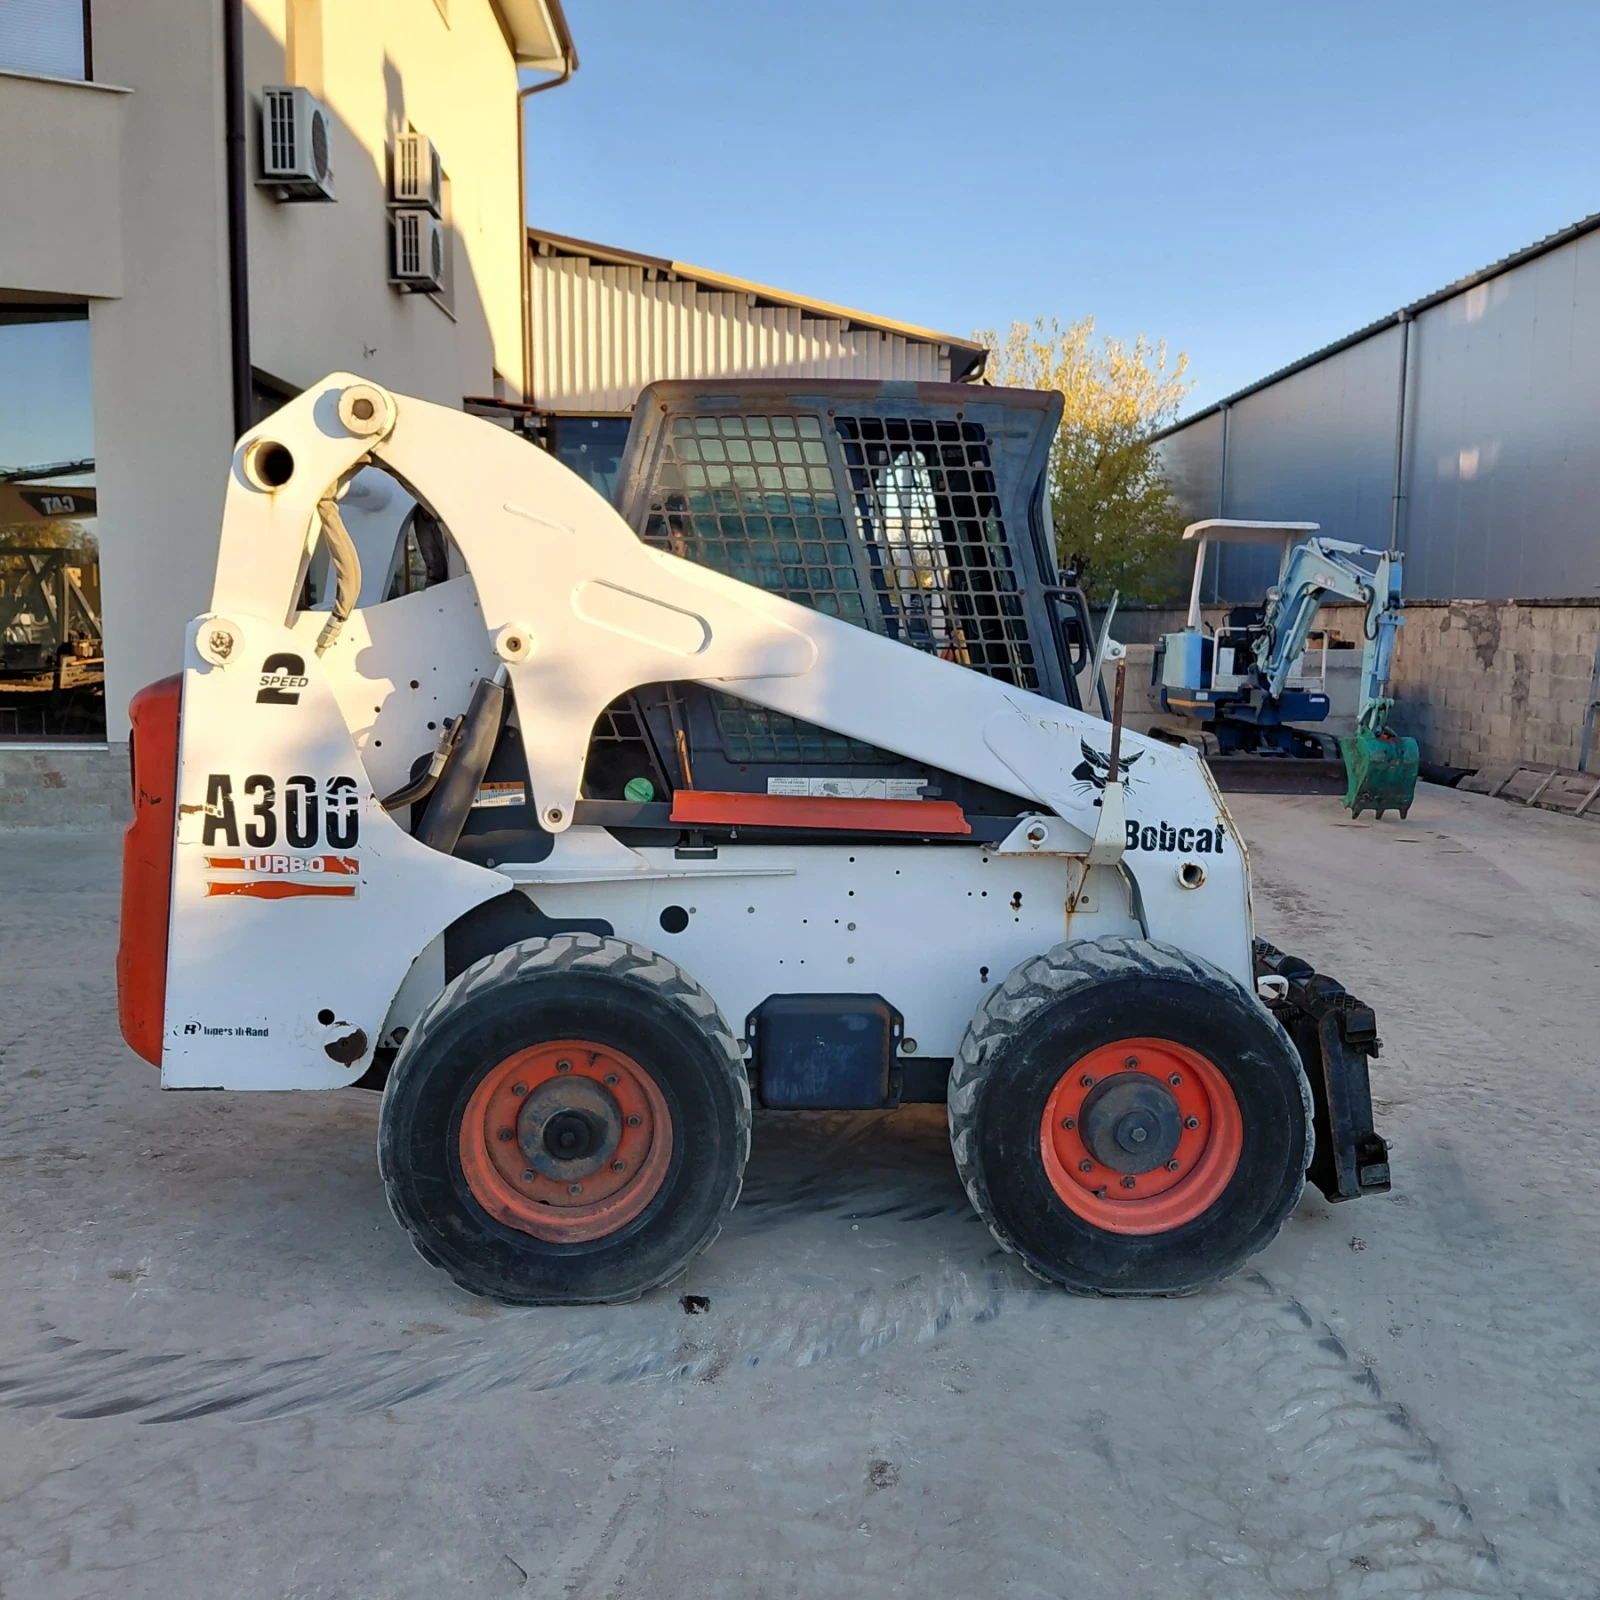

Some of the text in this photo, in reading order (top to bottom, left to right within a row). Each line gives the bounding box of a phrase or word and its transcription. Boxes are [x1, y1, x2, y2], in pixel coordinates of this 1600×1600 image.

[256, 652, 305, 705] 2
[259, 675, 309, 687] SPEED
[202, 774, 359, 849] A300
[1125, 820, 1225, 853] Bobcat
[240, 855, 324, 873] TURBO
